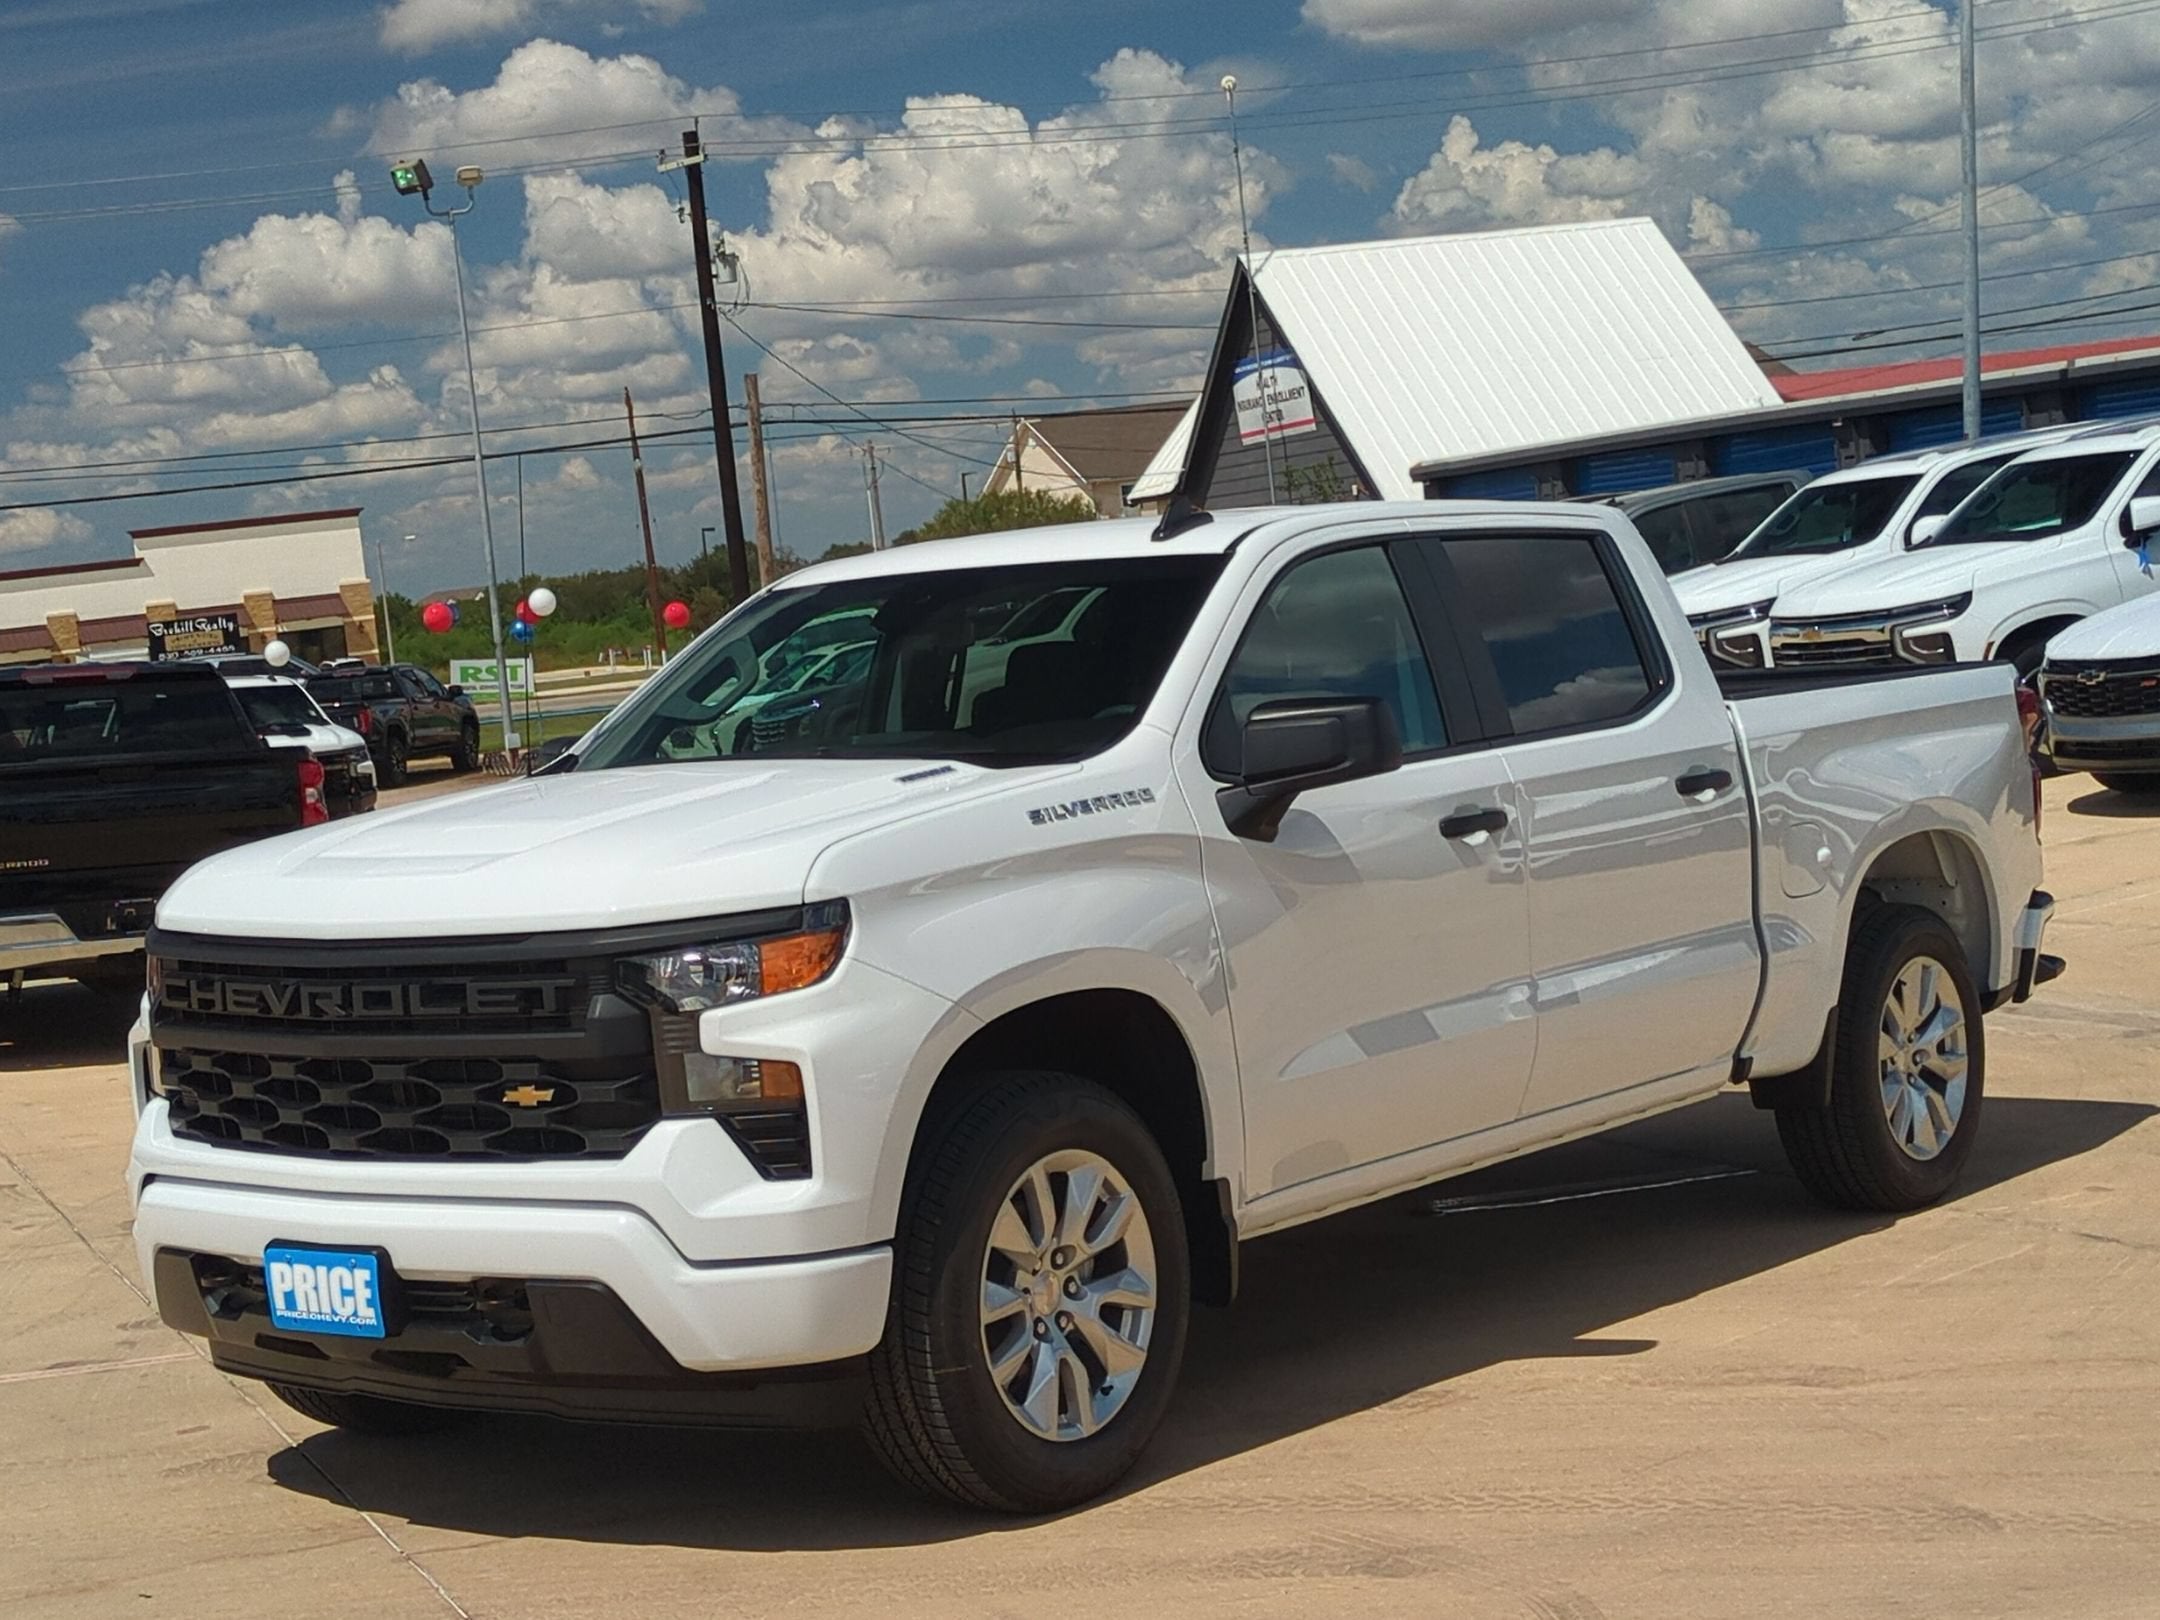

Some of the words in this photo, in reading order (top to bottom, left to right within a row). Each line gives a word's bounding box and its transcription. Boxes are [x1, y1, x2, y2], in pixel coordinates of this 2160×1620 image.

[459, 664, 524, 683] RST
[1026, 787, 1156, 825] SILVERADO
[160, 976, 576, 1018] CHEVROLET
[269, 1261, 376, 1318] PRICE
[276, 1309, 378, 1326] PRICECHEVY.COM
